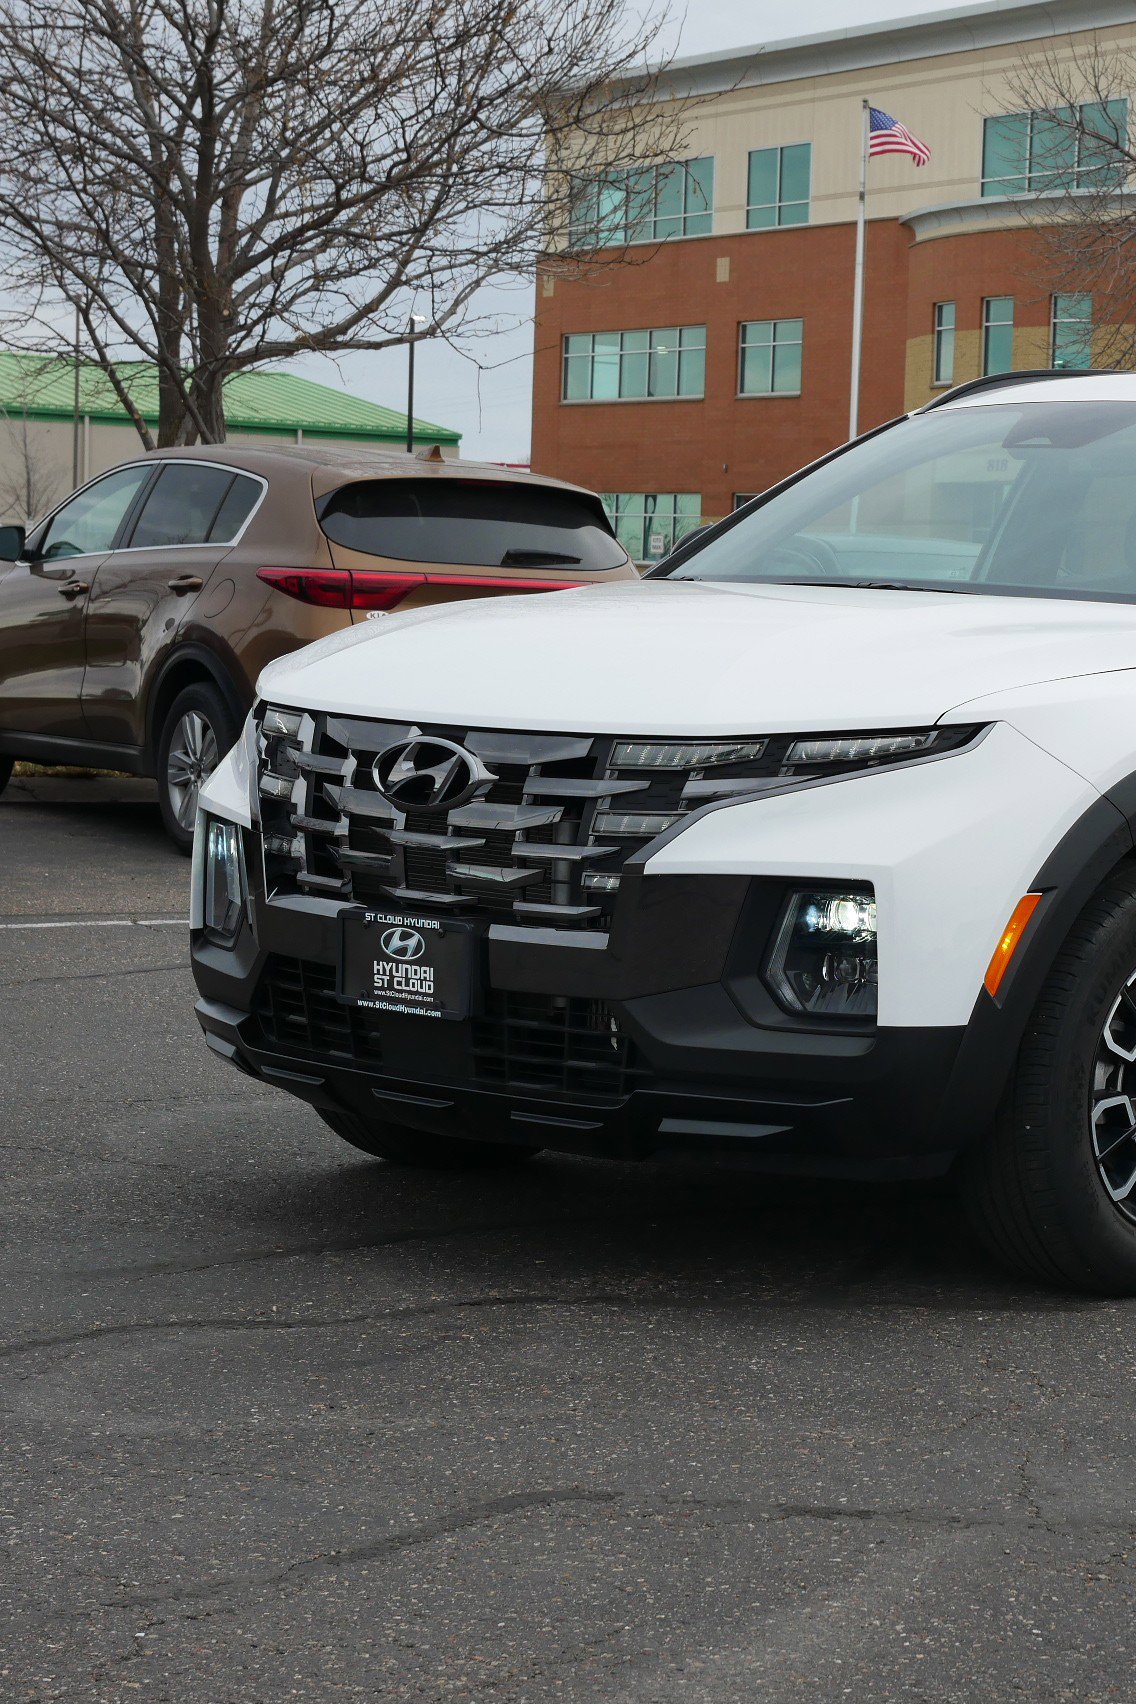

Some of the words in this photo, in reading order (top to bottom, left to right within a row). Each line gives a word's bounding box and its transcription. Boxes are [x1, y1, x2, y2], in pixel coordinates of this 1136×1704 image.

[365, 912, 376, 922] ST
[378, 915, 403, 924] CLOUD
[404, 917, 440, 929] HYUNDAI
[373, 960, 434, 981] HYUNDAI
[374, 975, 389, 987] ST
[393, 977, 434, 994] CLOUD
[357, 999, 442, 1017] www.StCloudHyundai.com
